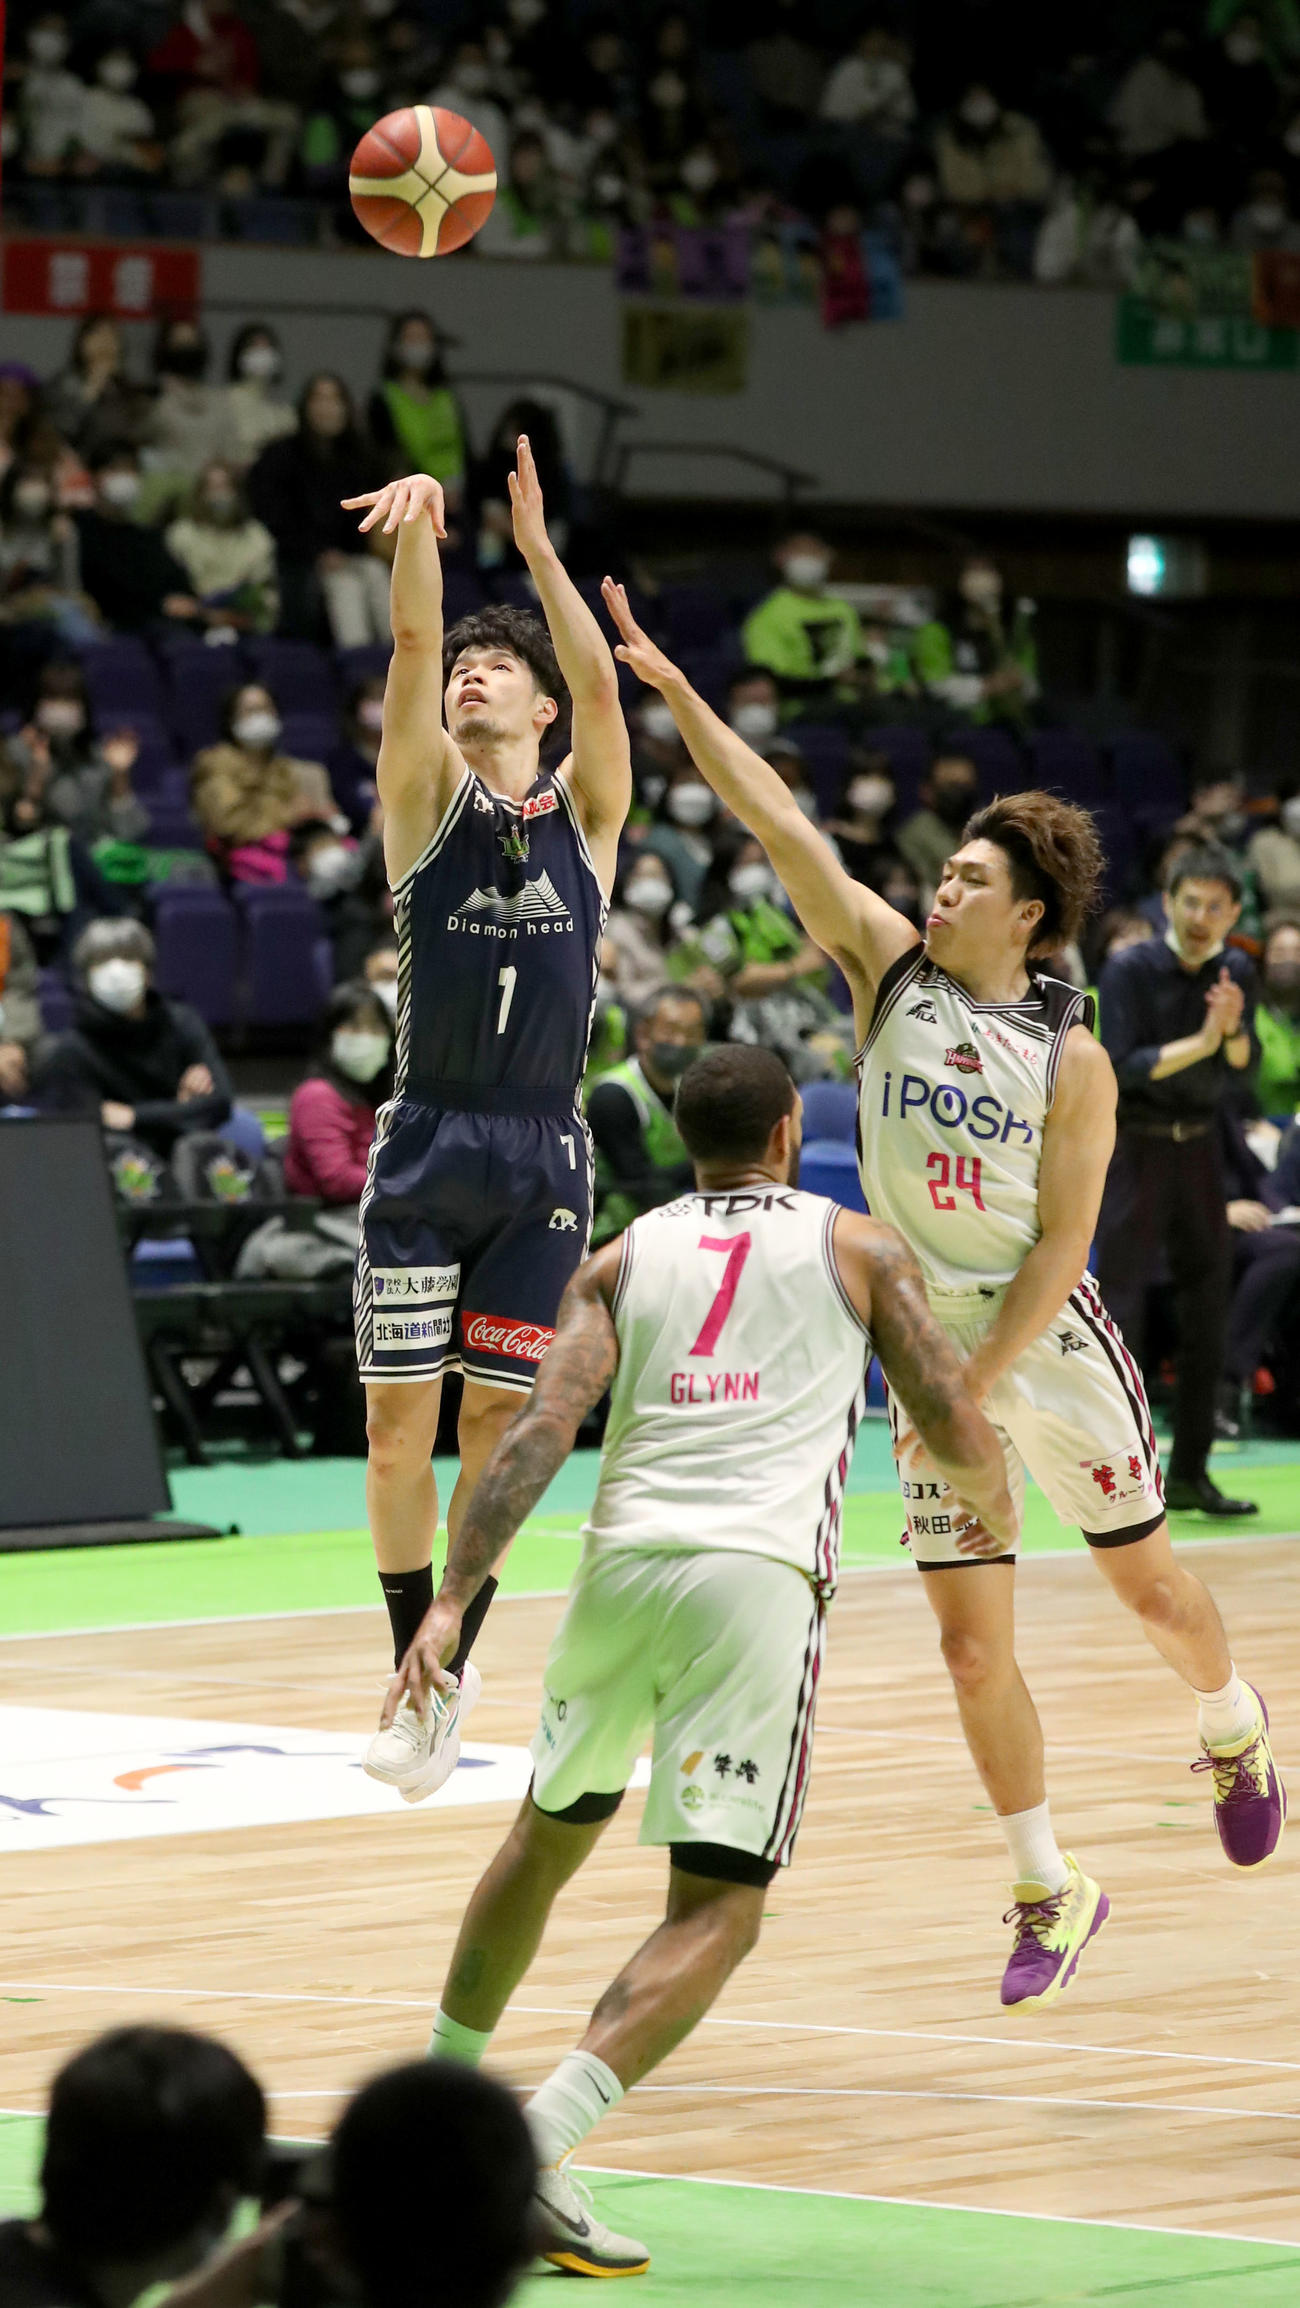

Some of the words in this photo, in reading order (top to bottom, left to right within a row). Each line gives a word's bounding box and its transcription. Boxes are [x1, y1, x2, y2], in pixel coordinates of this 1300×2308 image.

[526, 918, 574, 936] head
[497, 966, 517, 1034] 1
[905, 1008, 938, 1025] FILA
[926, 1152, 987, 1212] 24
[692, 1192, 799, 1217] TDK
[688, 1231, 751, 1358] 7
[376, 1317, 451, 1341] 北海道新聞社
[671, 1371, 760, 1404] GLYNN
[911, 1482, 951, 1500] コス
